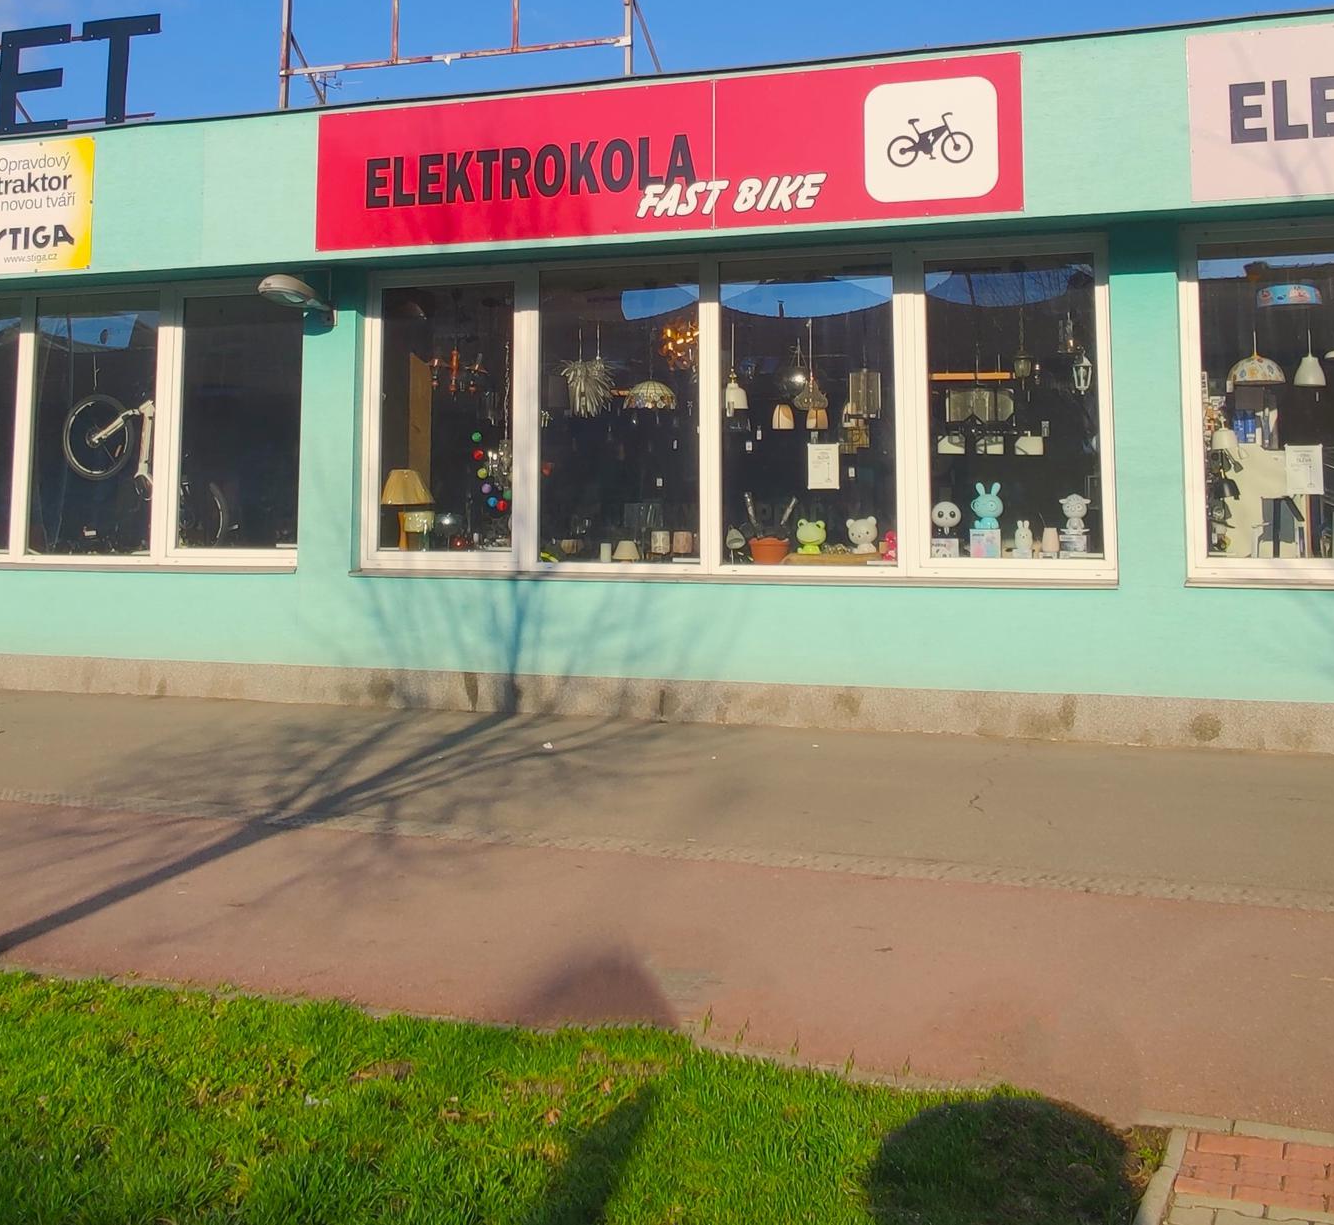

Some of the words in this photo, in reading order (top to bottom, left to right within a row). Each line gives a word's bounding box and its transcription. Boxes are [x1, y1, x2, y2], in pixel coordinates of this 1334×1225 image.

[365, 133, 698, 210] ELEKTROKOLA
[1, 196, 43, 211] novou
[46, 191, 76, 209] tváří
[636, 179, 729, 219] FAST
[734, 172, 828, 214] BIKE
[3, 252, 58, 264] www.stiga.cz
